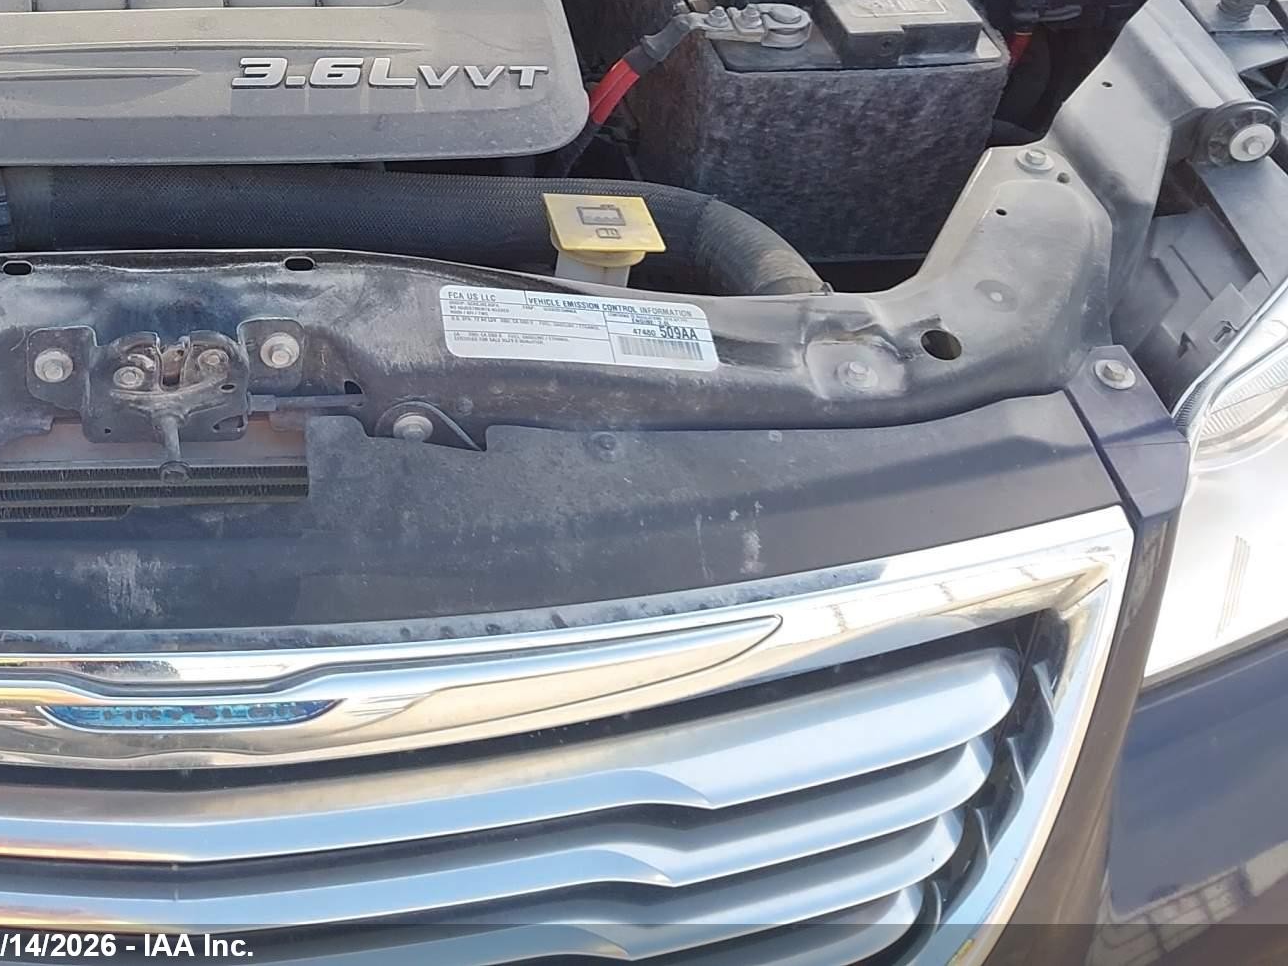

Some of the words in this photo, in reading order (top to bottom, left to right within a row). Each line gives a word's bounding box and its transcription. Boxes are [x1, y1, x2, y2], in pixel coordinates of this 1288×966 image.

[448, 291, 464, 299] FCA
[481, 294, 496, 302] LLC
[528, 297, 562, 307] VEHICLE
[563, 300, 600, 310] EMISSION
[602, 303, 637, 313] CONTROL
[640, 307, 692, 317] INFORMATION
[660, 326, 698, 340] 509AA
